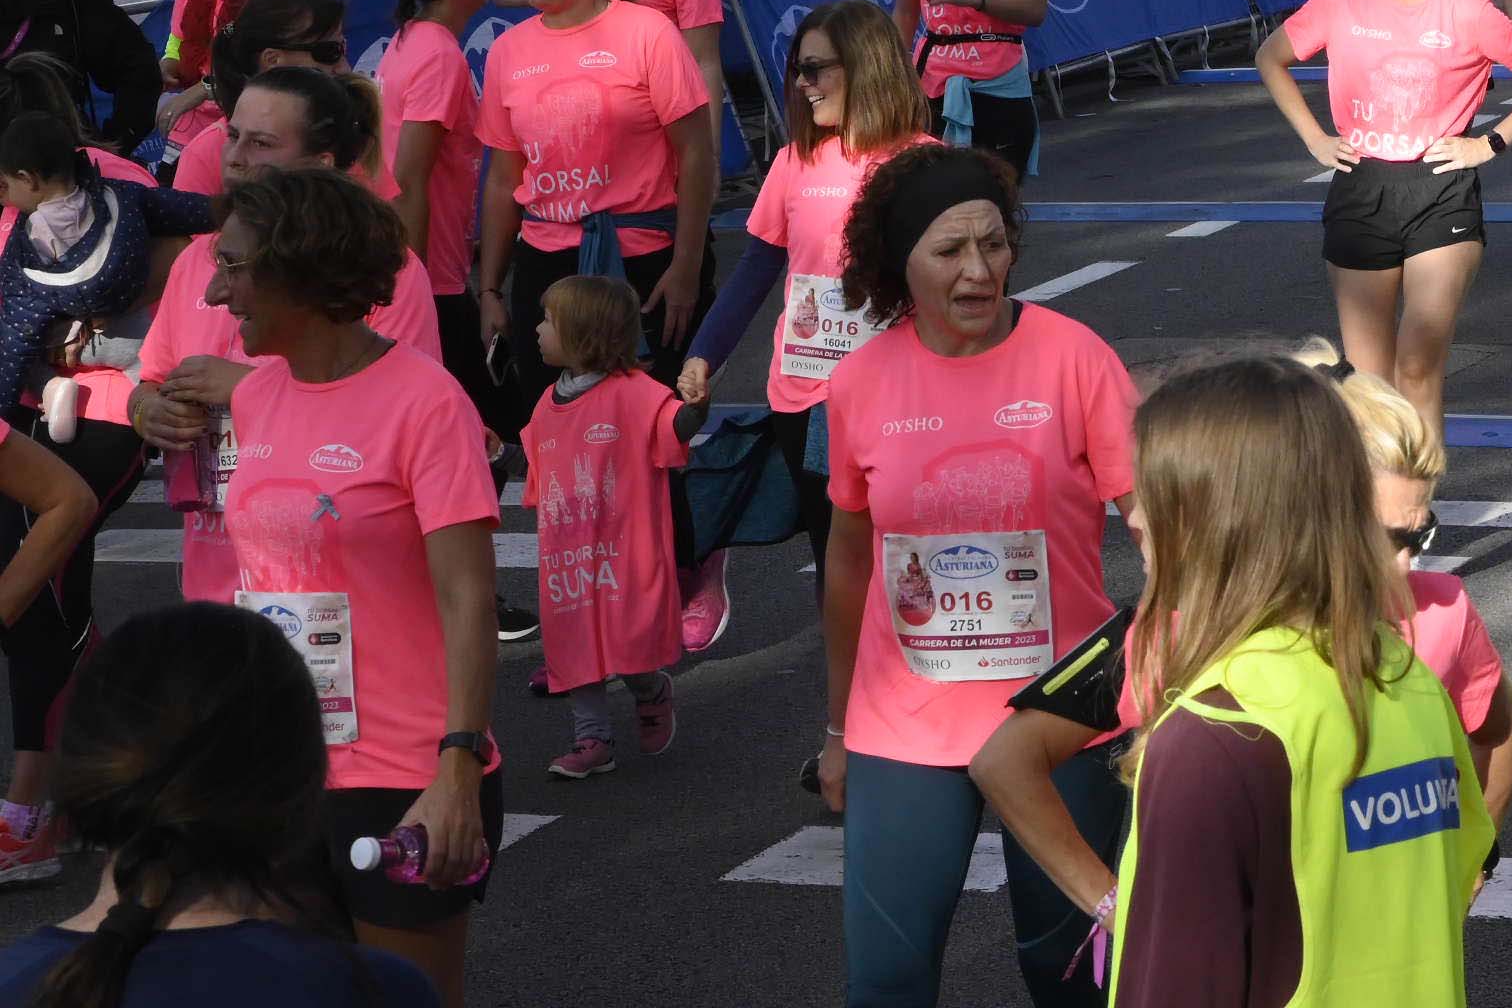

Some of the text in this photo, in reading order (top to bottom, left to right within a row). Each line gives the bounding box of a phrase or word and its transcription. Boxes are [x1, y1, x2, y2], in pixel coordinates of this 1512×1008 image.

[512, 63, 550, 80] OYSHO
[1352, 98, 1374, 122] TU
[801, 187, 847, 198] OYSHO
[821, 318, 858, 335] 016
[824, 337, 851, 349] 16041
[882, 416, 944, 436] OYSHO
[1004, 551, 1035, 560] SUMA
[934, 557, 994, 571] ASTURIANA
[939, 591, 993, 613] 016
[307, 613, 339, 623] SUMA
[950, 619, 982, 632] 2751
[909, 638, 949, 647] CARRERA
[950, 638, 962, 647] DE
[965, 638, 977, 647] LA
[979, 637, 1012, 646] MUJER
[991, 655, 1041, 668] Santander
